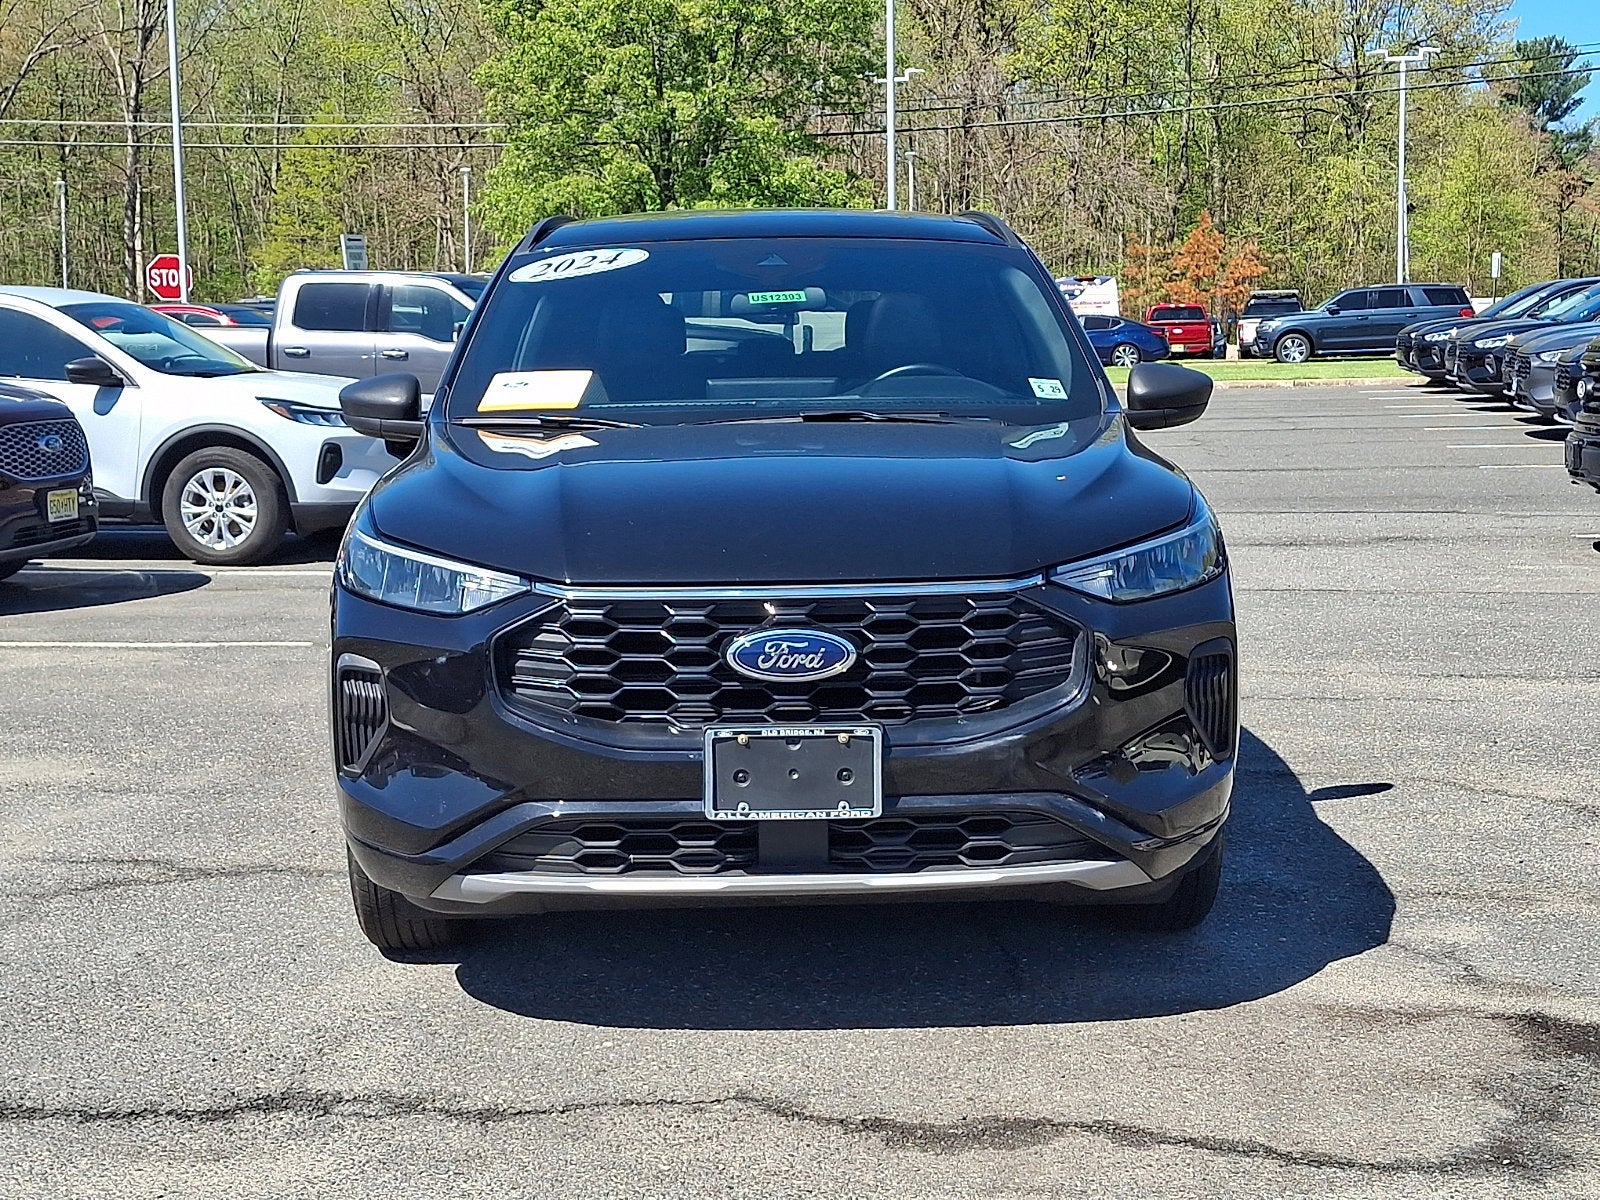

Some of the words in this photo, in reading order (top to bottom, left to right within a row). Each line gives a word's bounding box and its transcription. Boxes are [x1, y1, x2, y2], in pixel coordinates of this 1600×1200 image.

[529, 251, 624, 279] 2024
[150, 268, 182, 287] STO
[757, 640, 826, 670] Ford
[813, 728, 825, 736] NJ
[716, 812, 746, 820] ALL
[748, 811, 827, 820] AMERICAN
[830, 810, 872, 818] FORD
